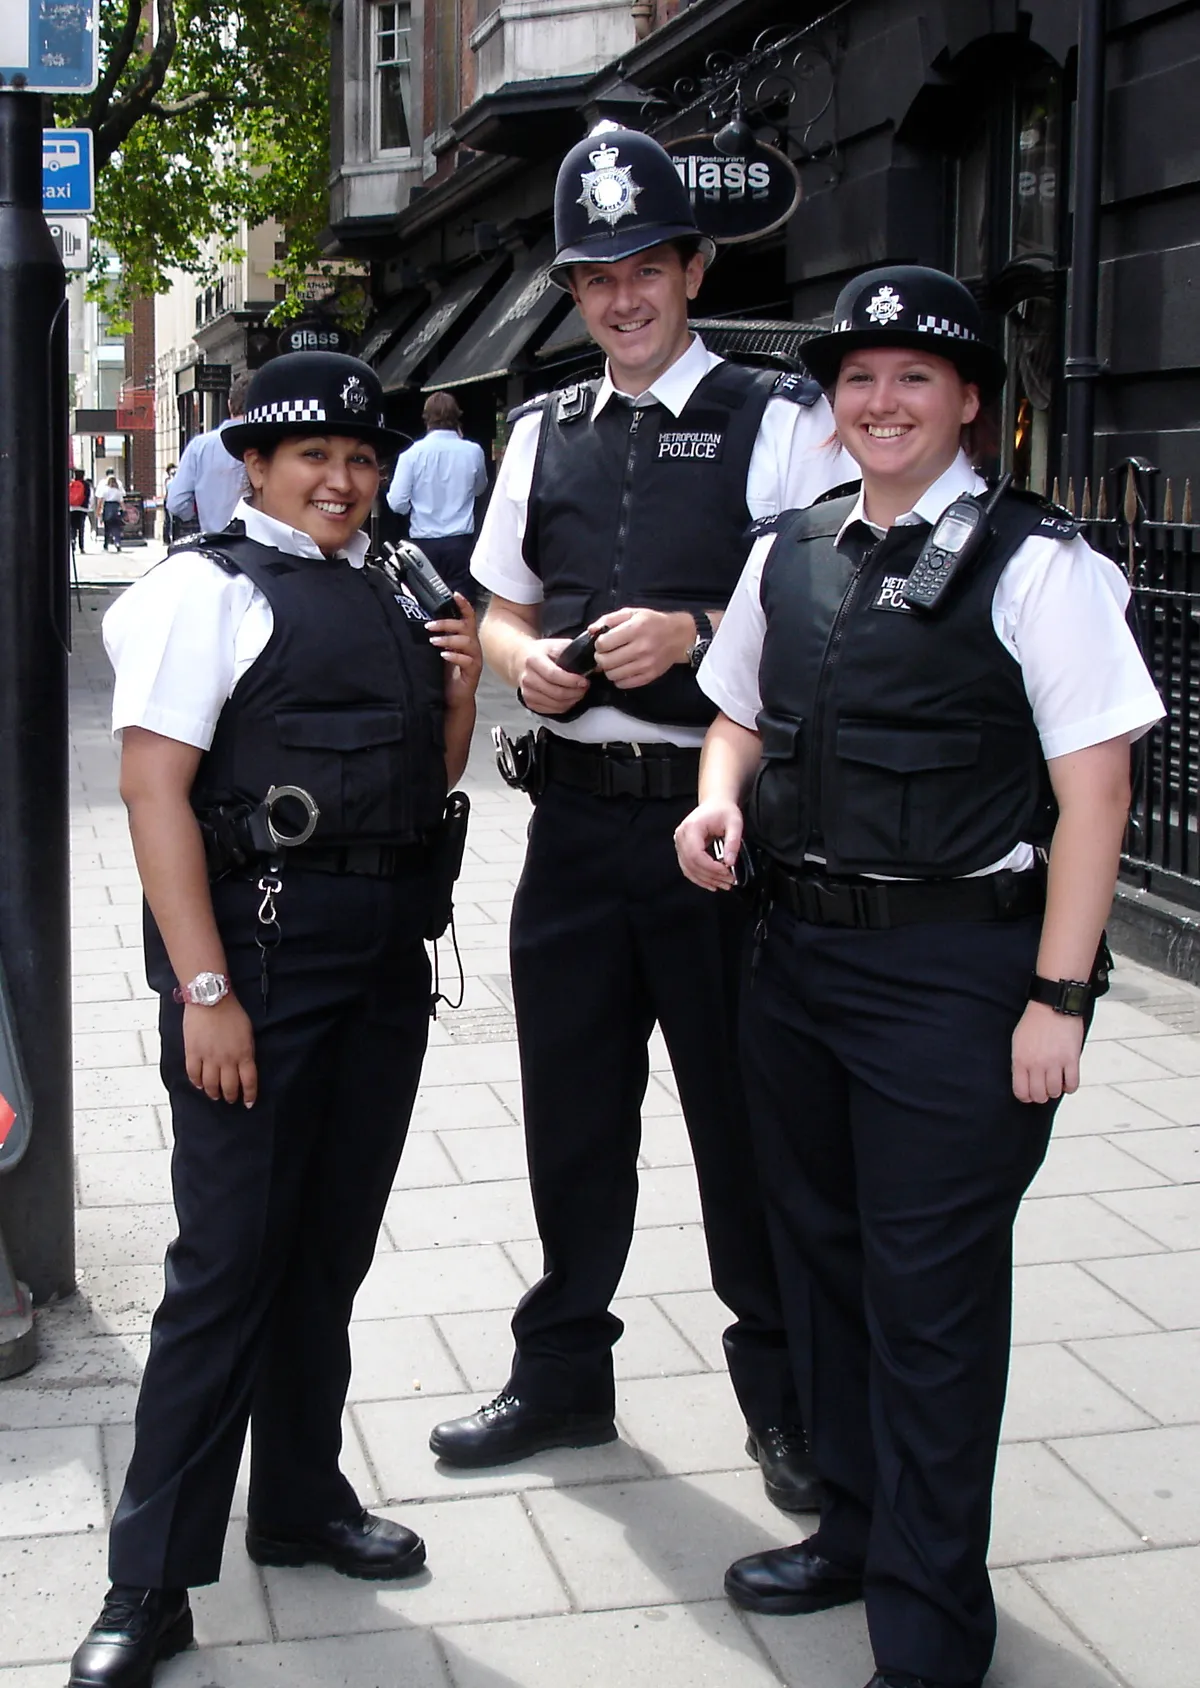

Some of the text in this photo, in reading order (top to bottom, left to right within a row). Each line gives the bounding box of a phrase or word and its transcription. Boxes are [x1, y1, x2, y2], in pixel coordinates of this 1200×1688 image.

[696, 155, 745, 164] Restaurant
[291, 330, 339, 349] glass
[658, 432, 721, 444] METROPOLITAN
[658, 442, 717, 458] POLICE
